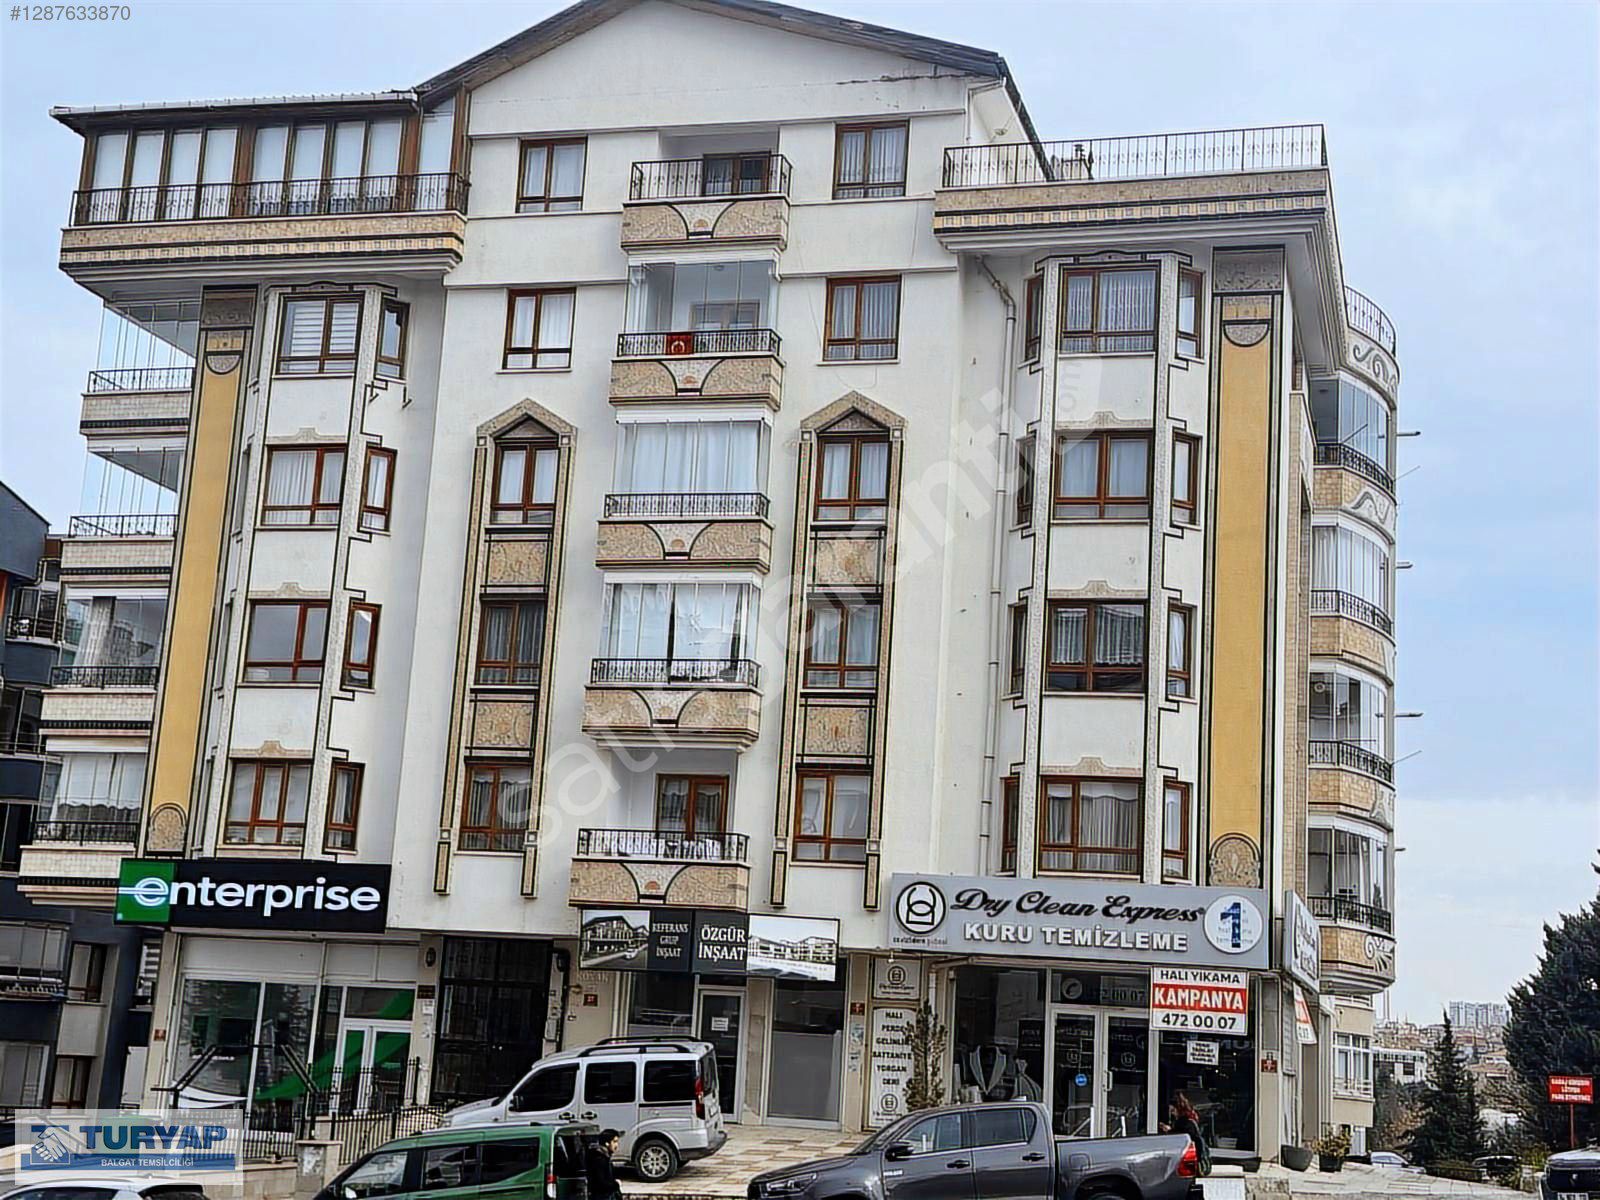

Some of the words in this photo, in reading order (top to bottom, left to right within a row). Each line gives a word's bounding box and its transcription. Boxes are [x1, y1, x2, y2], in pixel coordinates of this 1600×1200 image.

[118, 877, 381, 917] enterprise
[950, 888, 1013, 917] Dry
[1014, 891, 1098, 917] Clean
[1101, 895, 1205, 924] Express
[701, 924, 746, 942] ÖZGÜR
[964, 921, 1034, 944] KURU
[1040, 924, 1189, 952] TEMİZLEME
[1220, 902, 1242, 949] 1
[698, 941, 747, 962] İNŞAAT
[1160, 970, 1188, 981] HALI
[1191, 971, 1241, 984] YIKAMA
[1153, 986, 1244, 1010] KAMPANYA
[1161, 1013, 1189, 1027] 472
[1192, 1014, 1214, 1028] 00
[1217, 1016, 1237, 1030] 07
